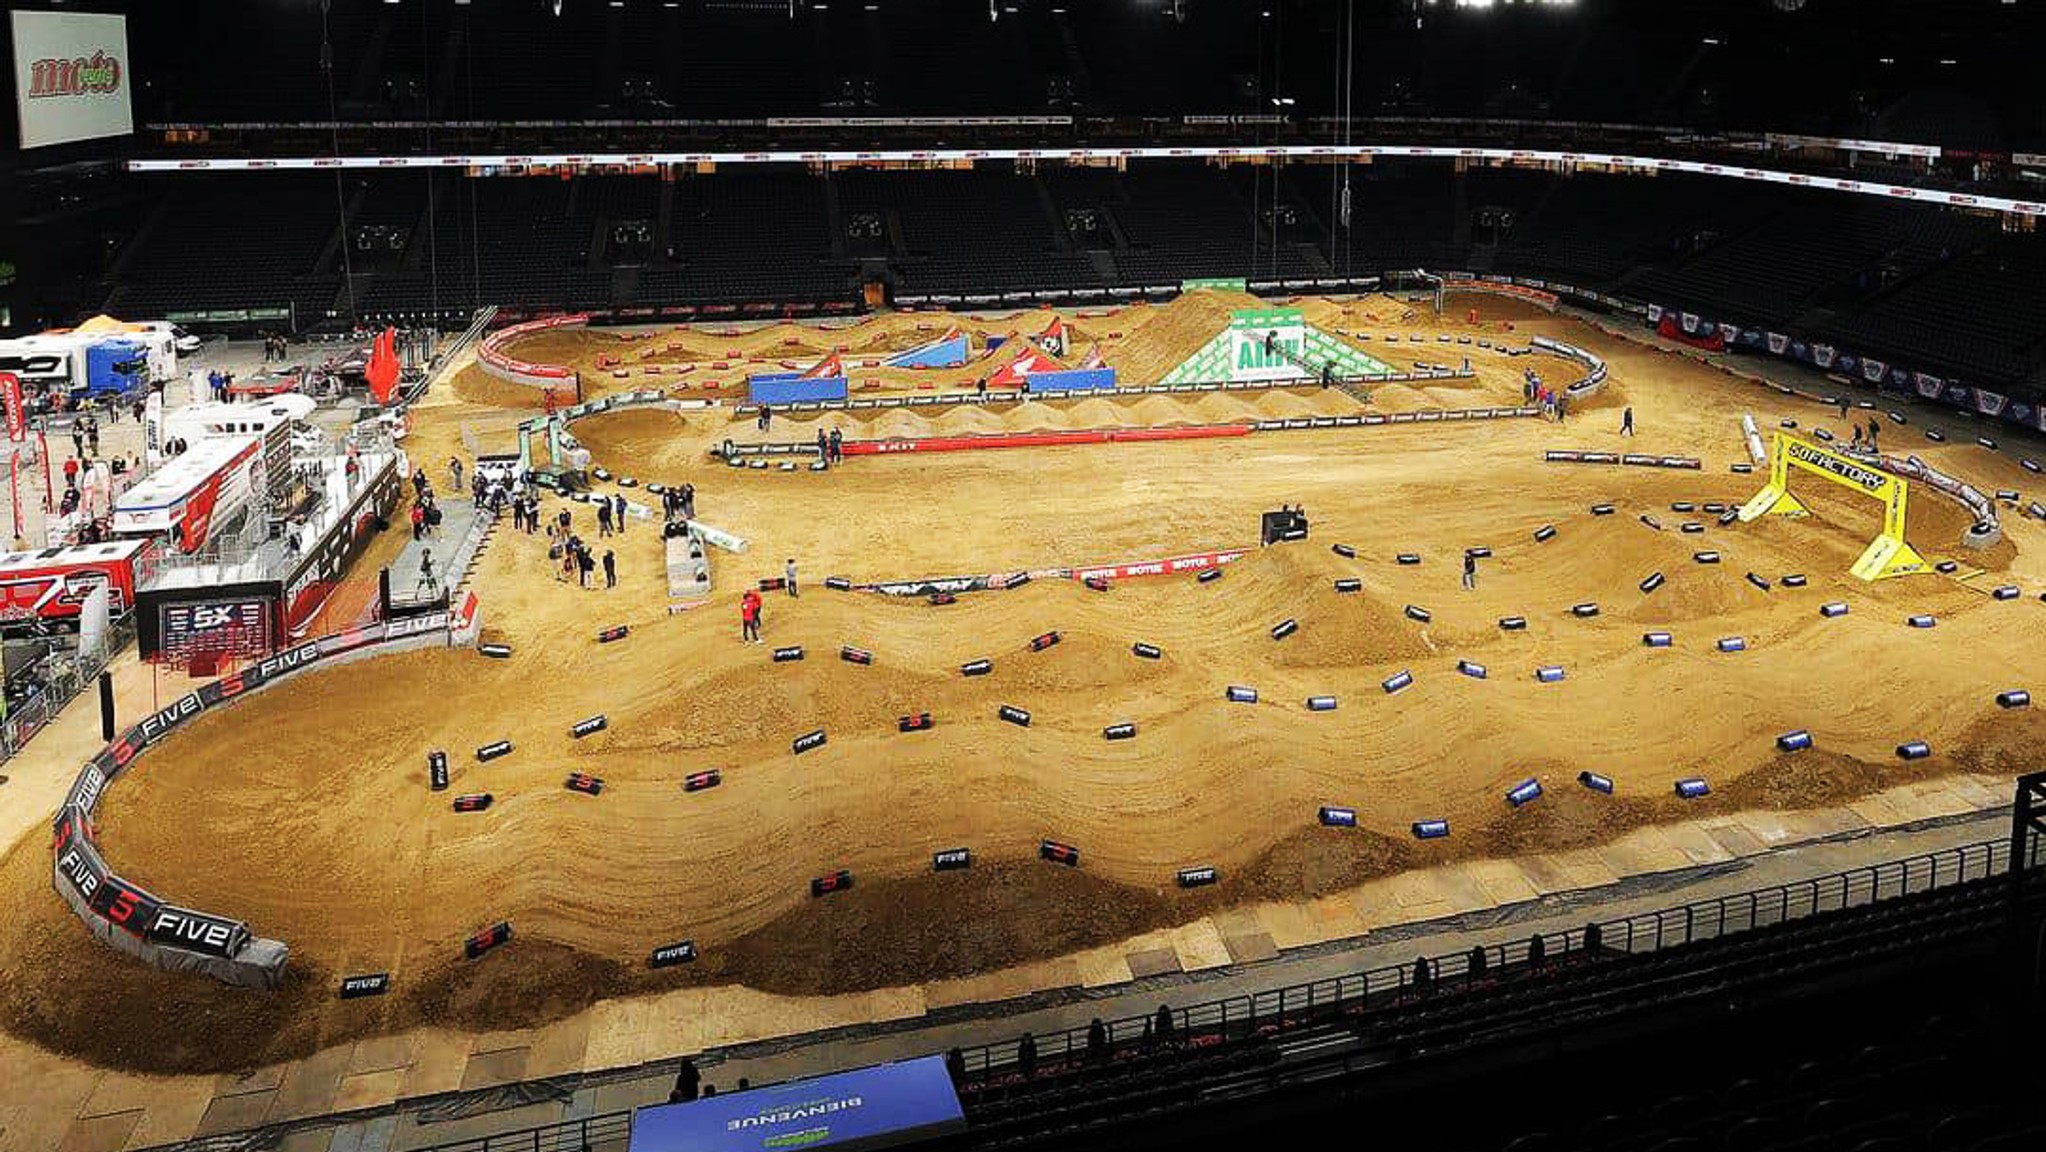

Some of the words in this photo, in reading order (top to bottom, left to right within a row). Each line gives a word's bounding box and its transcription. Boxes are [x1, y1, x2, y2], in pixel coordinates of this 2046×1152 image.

[1128, 563, 1163, 575] MOTUL
[1173, 557, 1208, 570] MOTUL
[388, 614, 448, 636] FIVE
[261, 644, 318, 678] FIVE
[220, 673, 244, 697] 5
[141, 695, 198, 736] FIVE
[76, 767, 101, 808] FIVE
[59, 851, 98, 896] FIVE
[153, 914, 231, 947] FIVE
[728, 1097, 862, 1131] BIENVENUE
